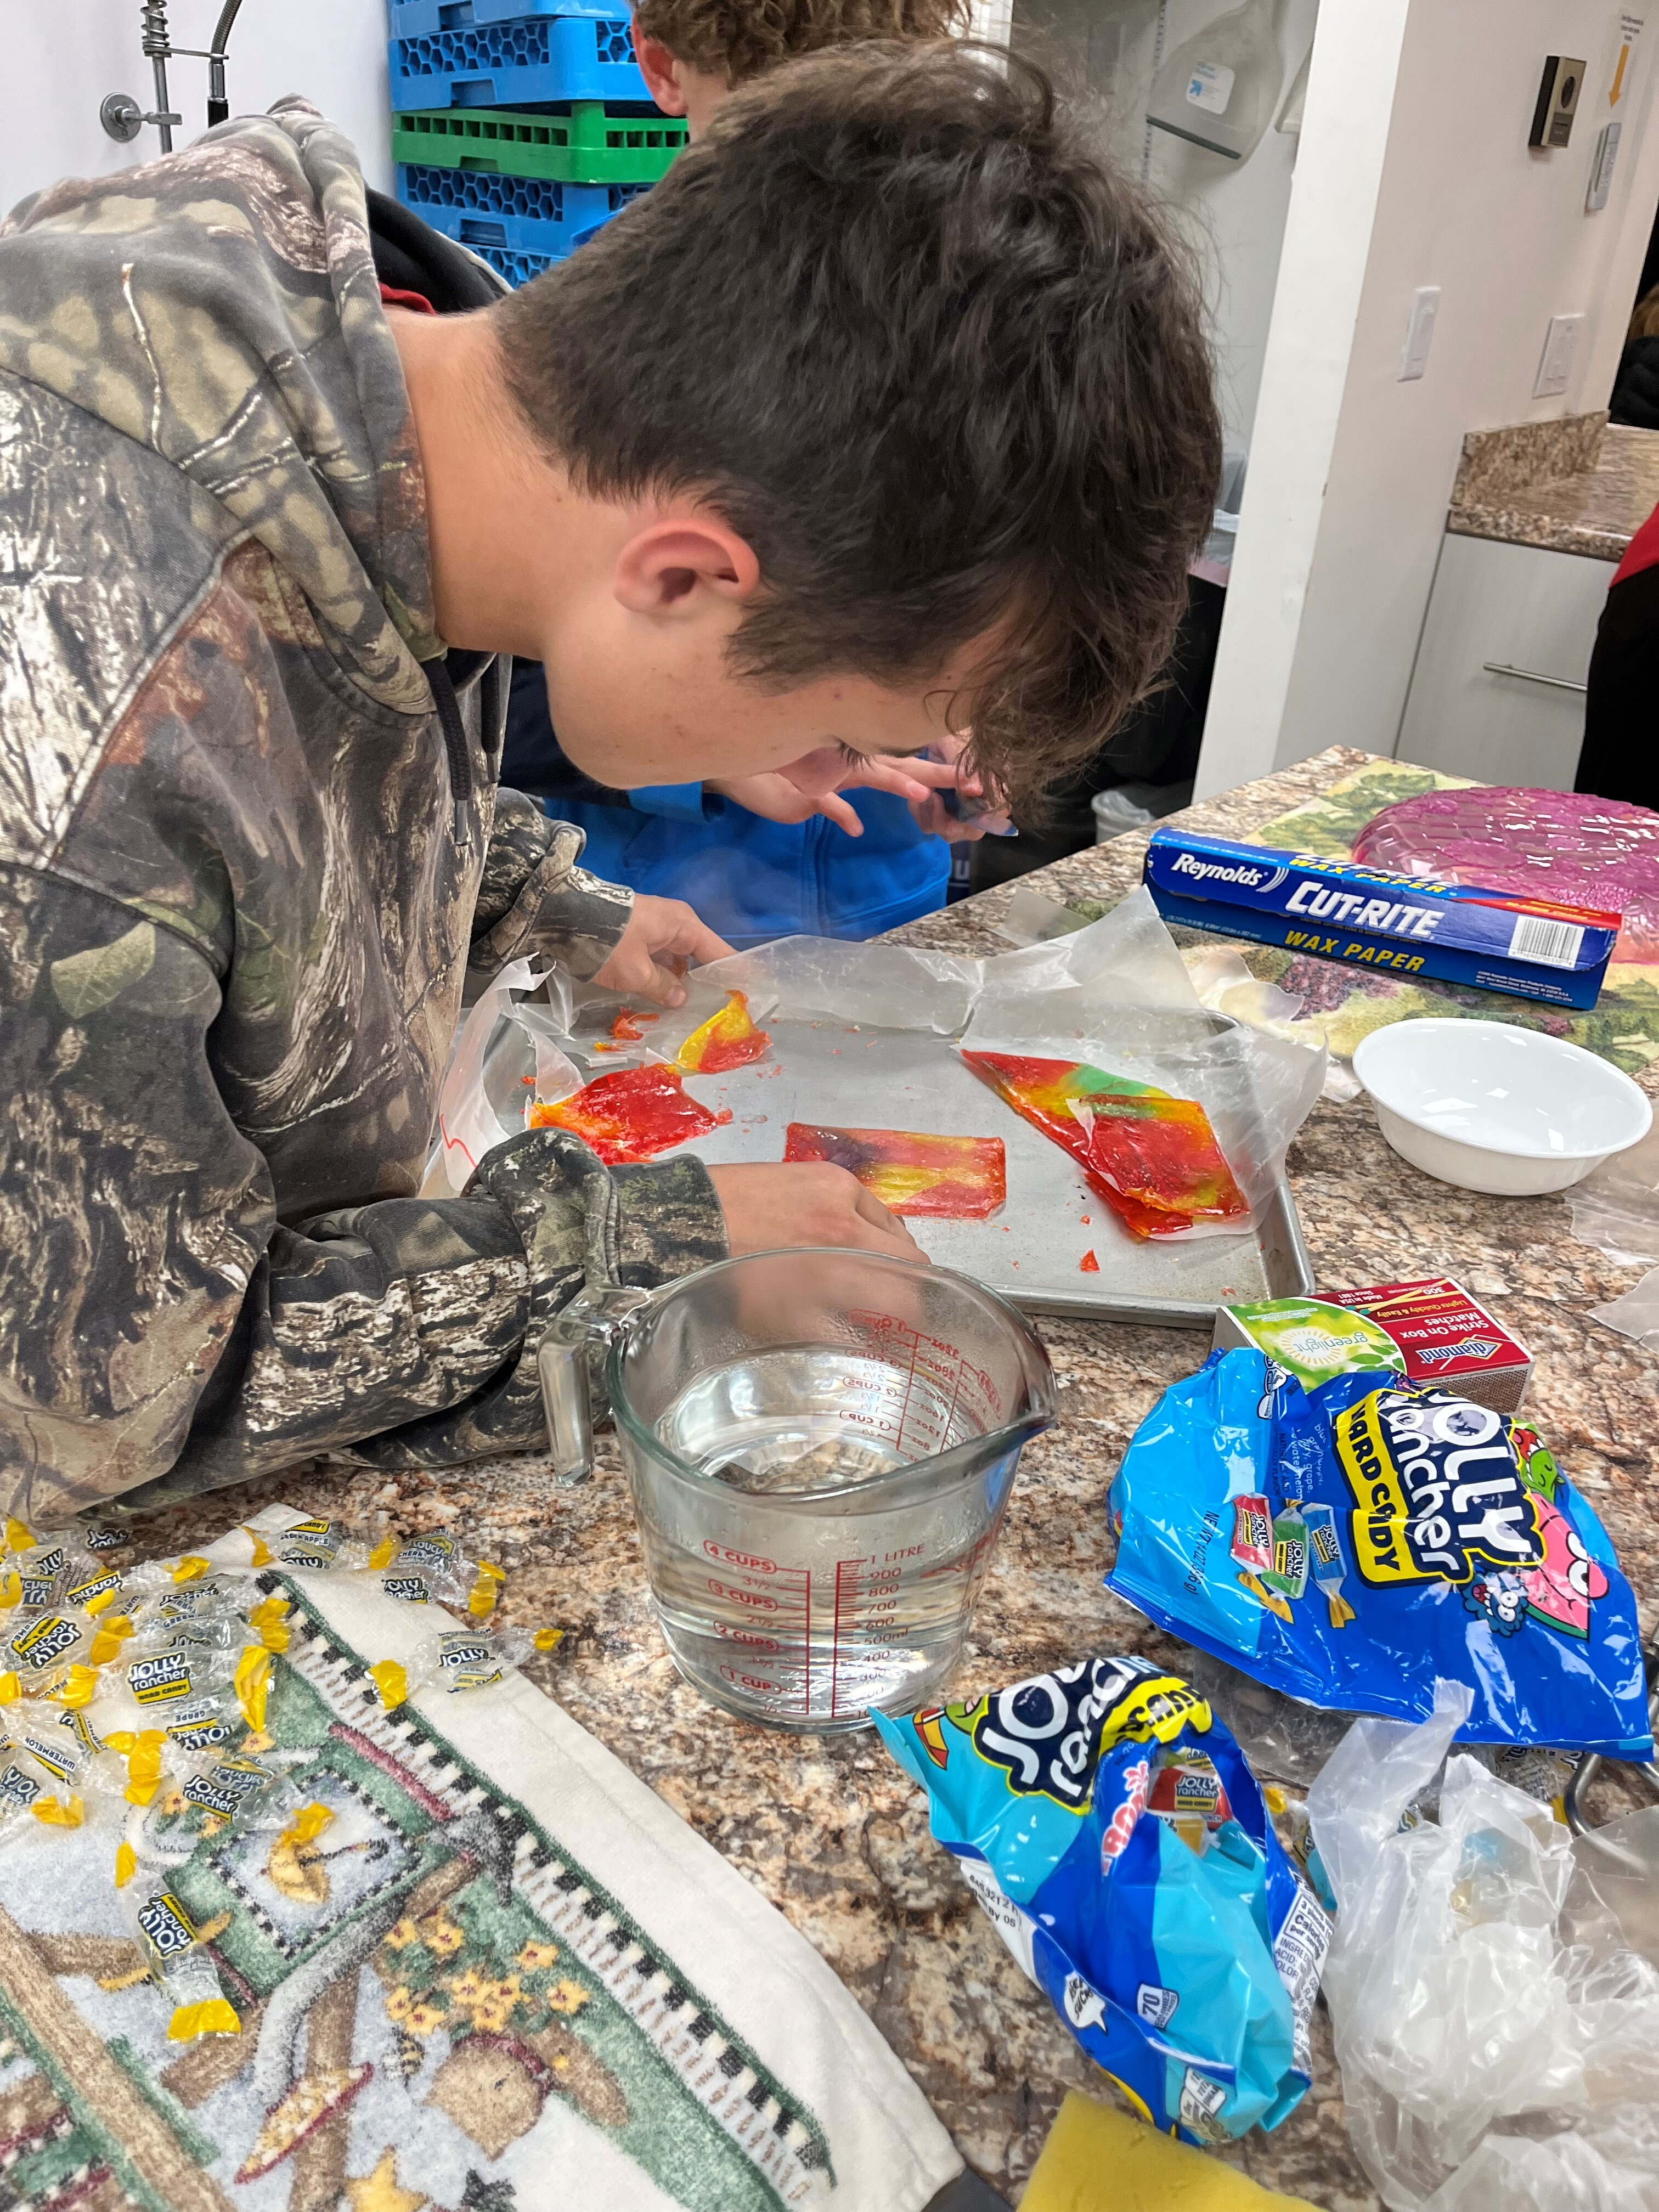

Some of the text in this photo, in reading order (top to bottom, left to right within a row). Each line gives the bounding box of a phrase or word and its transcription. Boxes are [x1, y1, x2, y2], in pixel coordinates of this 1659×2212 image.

[1171, 853, 1263, 886] Reynolds
[1289, 859, 1447, 893] WAX PAPER
[1285, 881, 1446, 939] CUT-RITE
[1284, 930, 1339, 953] WAX
[1344, 943, 1425, 972] PAPER
[1376, 1307, 1403, 1318] Easily
[1409, 1303, 1441, 1314] Quickly
[1442, 1299, 1468, 1310] Lights
[1399, 1319, 1489, 1339] Strike On Box
[1424, 1312, 1482, 1325] Matches
[1292, 1331, 1368, 1353] greenlight
[1417, 1342, 1488, 1363] diamond
[1429, 1392, 1533, 1554] JOLLY
[303, 1521, 326, 1530] CANDY
[1250, 1514, 1259, 1547] rancher
[1255, 1514, 1270, 1548] JOLLY
[304, 1535, 329, 1545] APPLE
[1319, 1530, 1335, 1560] rancher
[1323, 1525, 1340, 1558] JOLLY
[38, 1550, 62, 1576] OLLY
[709, 1545, 772, 1572] 4 CUPS
[885, 1543, 926, 1562] LITRE
[1292, 1541, 1304, 1579] JOLLY
[71, 1576, 117, 1603] rancher
[713, 1582, 773, 1610] 3 CUPS
[868, 1583, 899, 1597] 800
[867, 1600, 897, 1614] 700
[164, 1614, 195, 1628] GREEN
[865, 1616, 895, 1631] 600
[34, 1624, 80, 1666] JOLLY
[718, 1624, 775, 1650] 2 CUPS
[864, 1627, 909, 1645] 500ml
[129, 1654, 182, 1683] JOLLY
[442, 1649, 486, 1667] JOLLY
[133, 1668, 186, 1691] rancher
[741, 1675, 772, 1691] CUP
[175, 1710, 205, 1723] GRAPE
[184, 1725, 230, 1751] JOLLY
[25, 1735, 76, 1771] WATERMELON
[185, 1775, 240, 1801] JOLLY
[1177, 1776, 1218, 1789] JOLLY
[1177, 1786, 1218, 1798] rancher
[184, 1789, 235, 1813] rancher
[1204, 1814, 1223, 1823] UNCH
[139, 1909, 182, 1955] JOLLY
[151, 1900, 191, 1946] rancher
[1276, 1960, 1300, 1980] OLOR
[1141, 1991, 1161, 2018] 70
